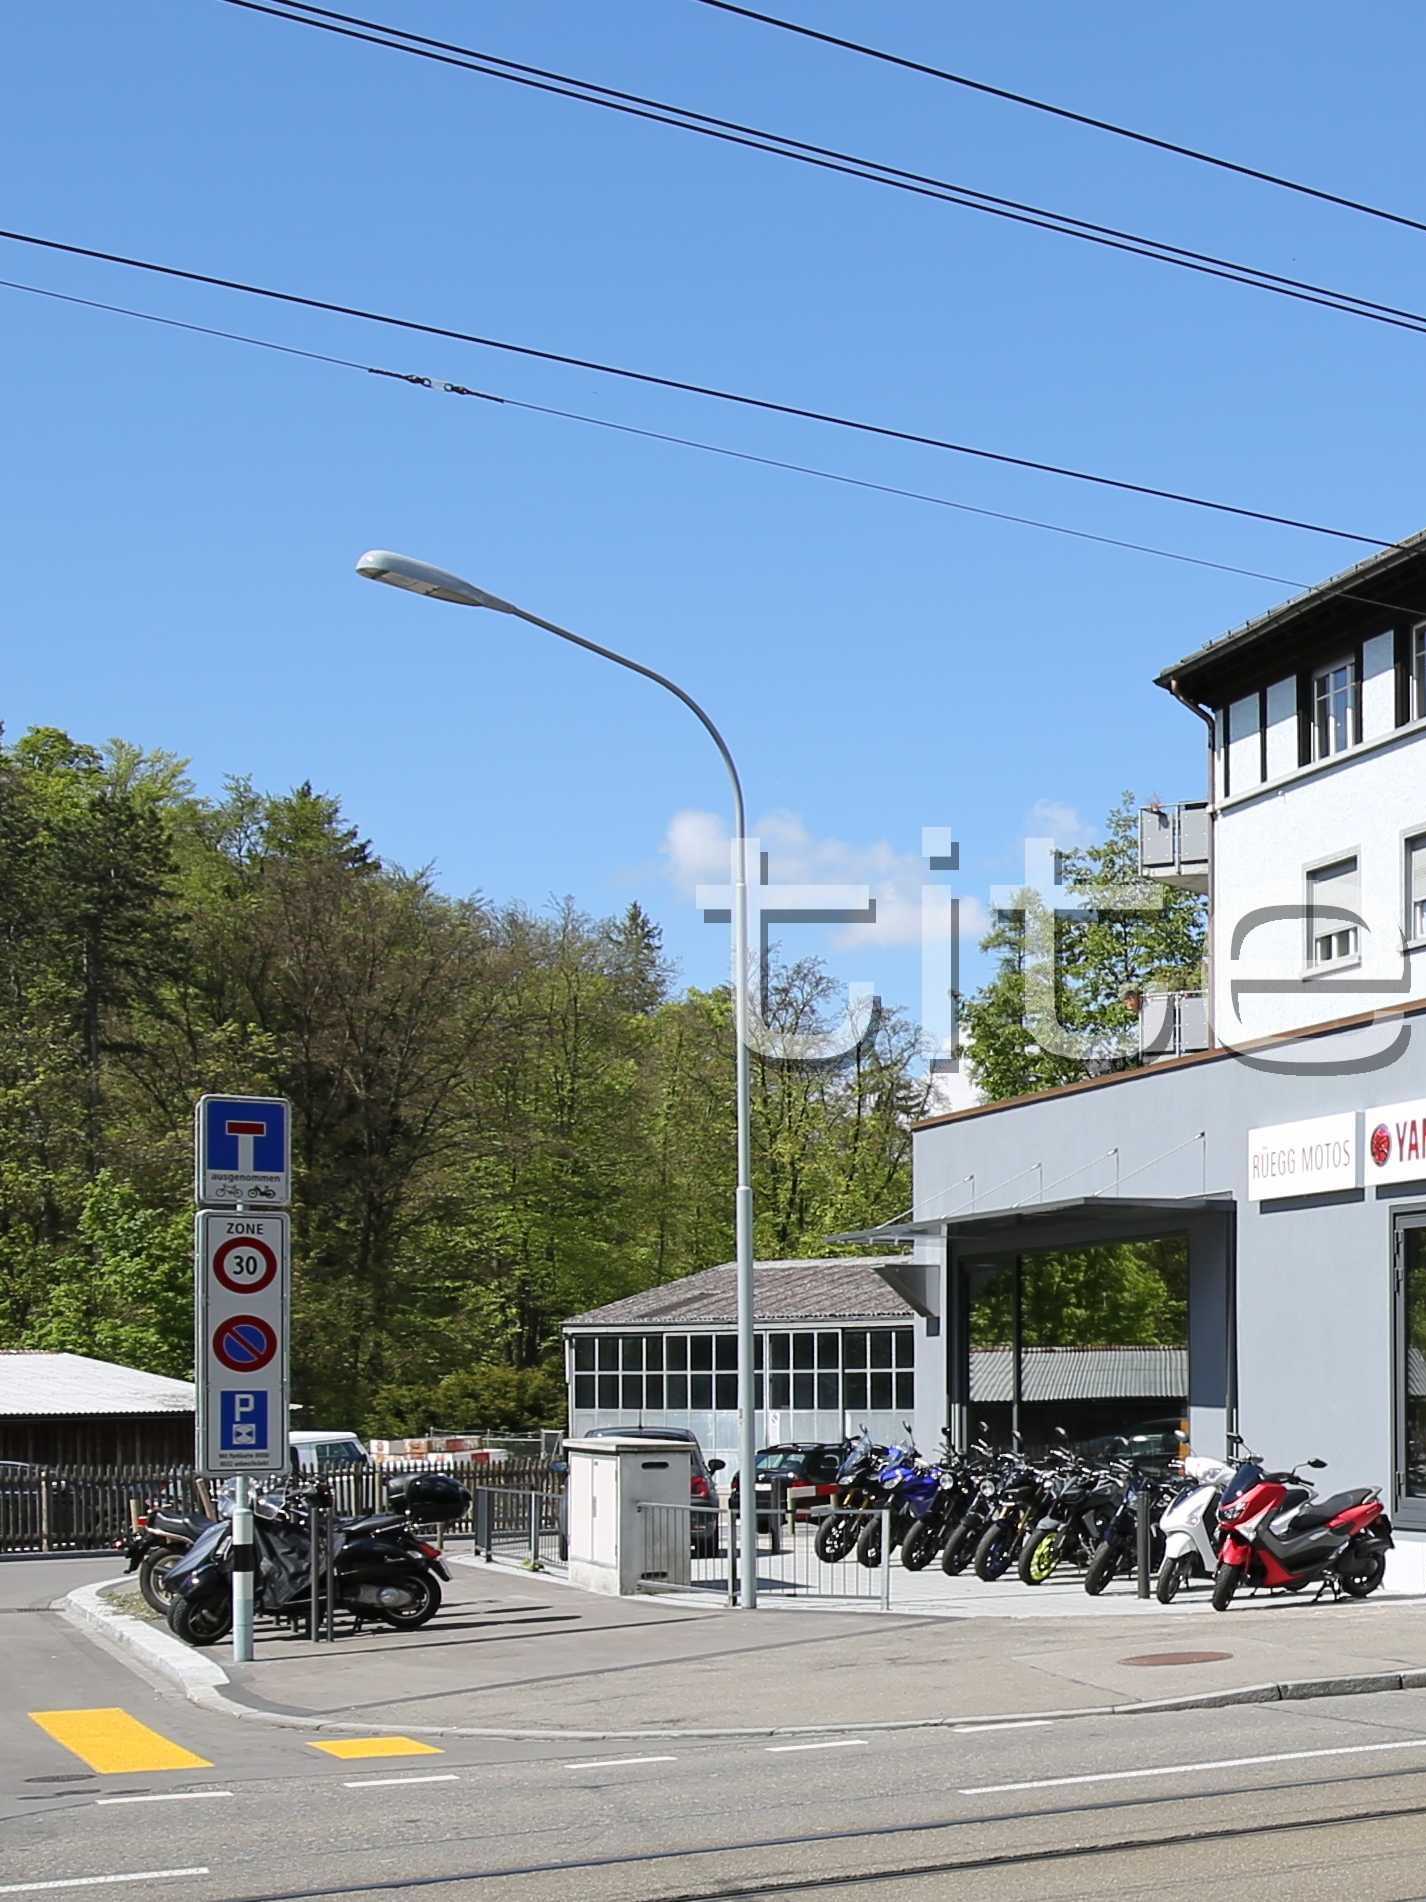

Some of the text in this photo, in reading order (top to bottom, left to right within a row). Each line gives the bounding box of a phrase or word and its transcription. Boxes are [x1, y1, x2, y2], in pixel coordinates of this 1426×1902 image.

[1253, 1139, 1350, 1180] RÜEGG MOTOS
[211, 1173, 281, 1183] ausgenommen
[226, 1222, 264, 1235] ZONE
[233, 1255, 258, 1276] 30
[235, 1394, 254, 1422] P
